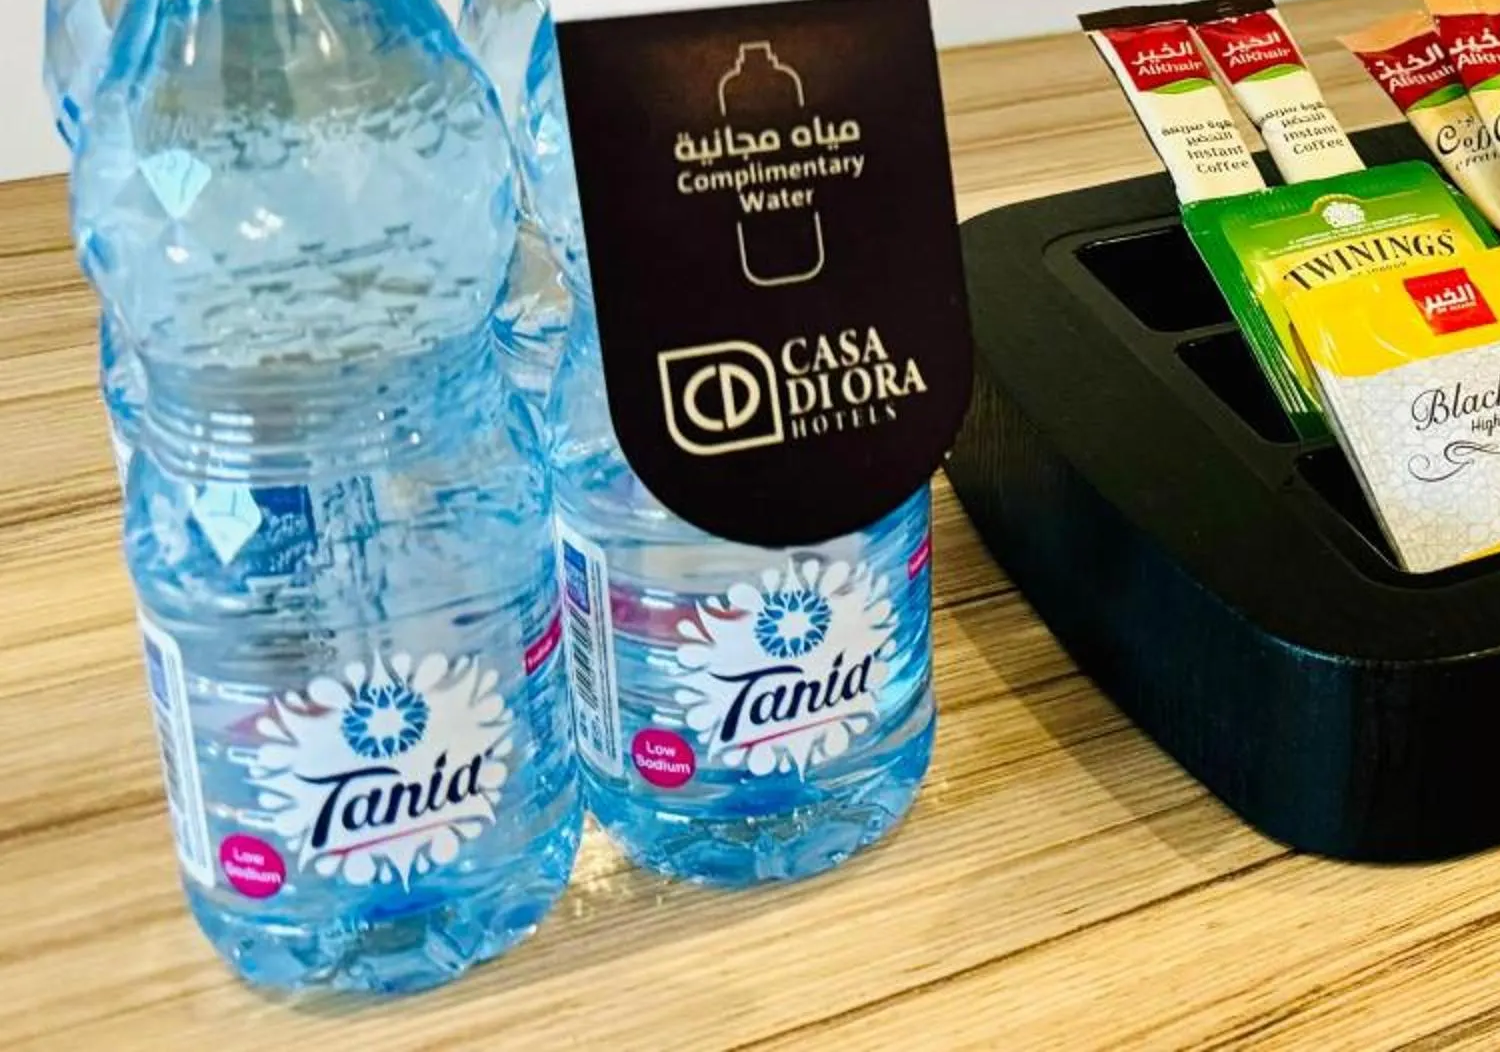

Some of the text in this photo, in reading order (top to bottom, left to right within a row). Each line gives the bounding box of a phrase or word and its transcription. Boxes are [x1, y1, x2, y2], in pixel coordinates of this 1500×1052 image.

[674, 115, 861, 166] مياه مجانية
[1283, 125, 1337, 143] Instant
[1293, 138, 1345, 155] Coffee
[1186, 145, 1243, 160] Instant
[1196, 159, 1249, 173] Coffee
[677, 154, 865, 194] Complimentary
[739, 188, 815, 213] Water
[1283, 233, 1455, 290] TWININGS
[1424, 283, 1476, 318] الخير
[781, 325, 889, 376] CASA
[786, 357, 928, 415] DI ORA
[791, 403, 898, 440] HOTELS
[1471, 414, 1500, 437] High
[710, 650, 876, 743] Tania
[635, 753, 691, 775] Sodium
[645, 739, 676, 757] Low
[295, 750, 487, 848] Tania
